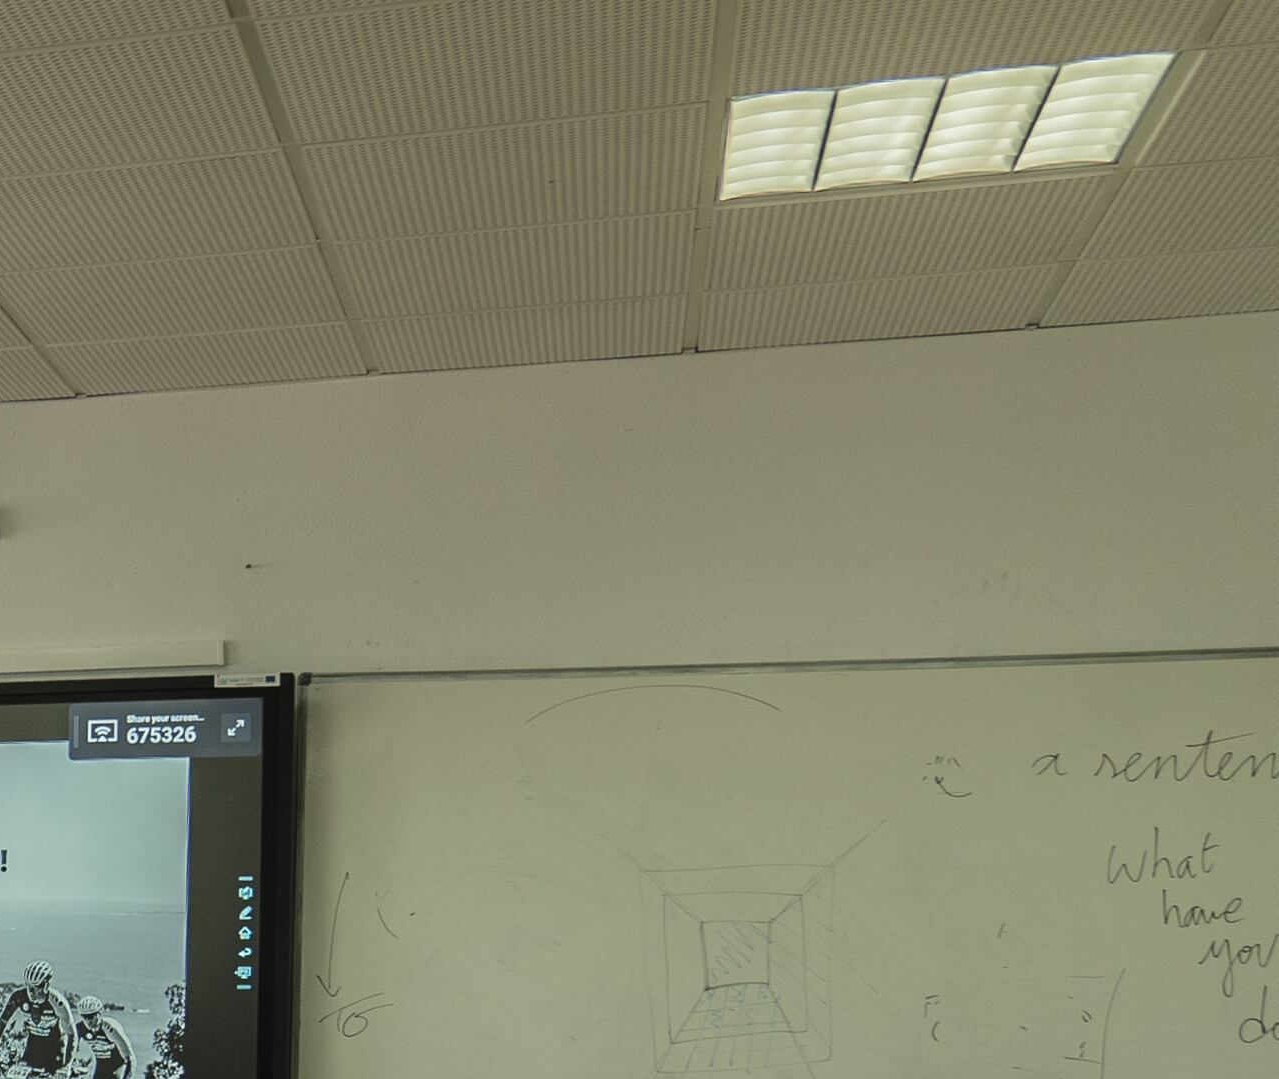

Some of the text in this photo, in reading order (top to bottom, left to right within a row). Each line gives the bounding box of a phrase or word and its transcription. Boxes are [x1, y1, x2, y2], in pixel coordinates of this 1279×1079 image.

[126, 714, 151, 724] Share
[151, 714, 170, 725] your
[126, 726, 197, 744] 675326
[1162, 889, 1244, 928] have
